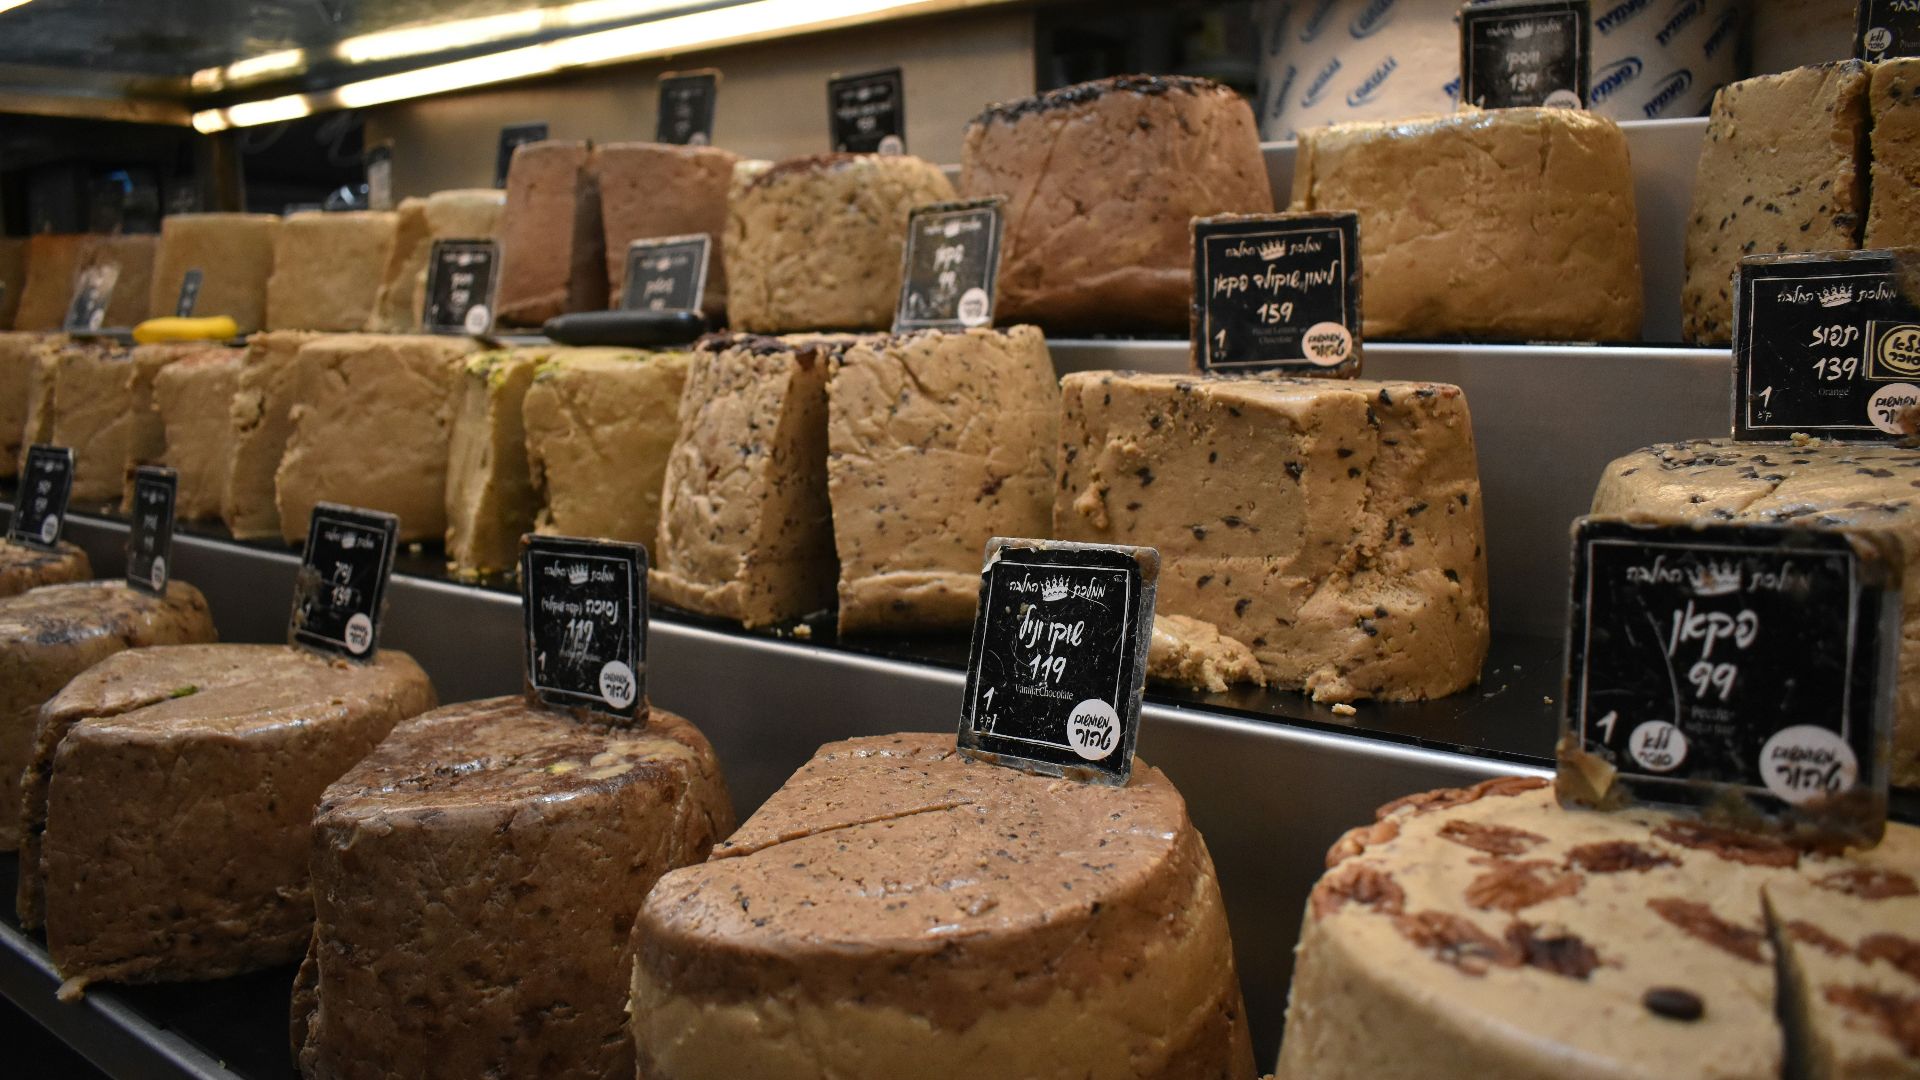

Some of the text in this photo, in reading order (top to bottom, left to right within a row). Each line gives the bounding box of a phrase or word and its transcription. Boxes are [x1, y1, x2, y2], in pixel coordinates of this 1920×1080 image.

[1510, 72, 1538, 92] 139
[1225, 236, 1322, 258] ממלכת החלבה
[1213, 260, 1339, 299] לימון שוקולד פקאן
[1778, 282, 1897, 304] ממלכת החלבה
[1256, 302, 1294, 324] 159
[1215, 329, 1226, 348] 1
[1809, 324, 1859, 348] תפוז
[1812, 357, 1859, 381] 139
[1759, 386, 1773, 408] 1
[1818, 388, 1849, 399] Orange
[1626, 555, 1682, 585] החלבה
[1009, 572, 1107, 599] ממלכת החלבה
[566, 618, 593, 643] 119
[1669, 600, 1759, 659] פקאן
[537, 651, 547, 671] 1
[1029, 654, 1067, 684] 119
[1015, 683, 1074, 700] Vanilla Chocolate
[1688, 661, 1737, 699] 99
[983, 687, 995, 711] 1
[1074, 714, 1110, 730] משומשום
[1596, 710, 1618, 744] 1
[1075, 725, 1113, 751] טהור
[1643, 726, 1673, 750] ללא
[1776, 762, 1843, 791] טהור
